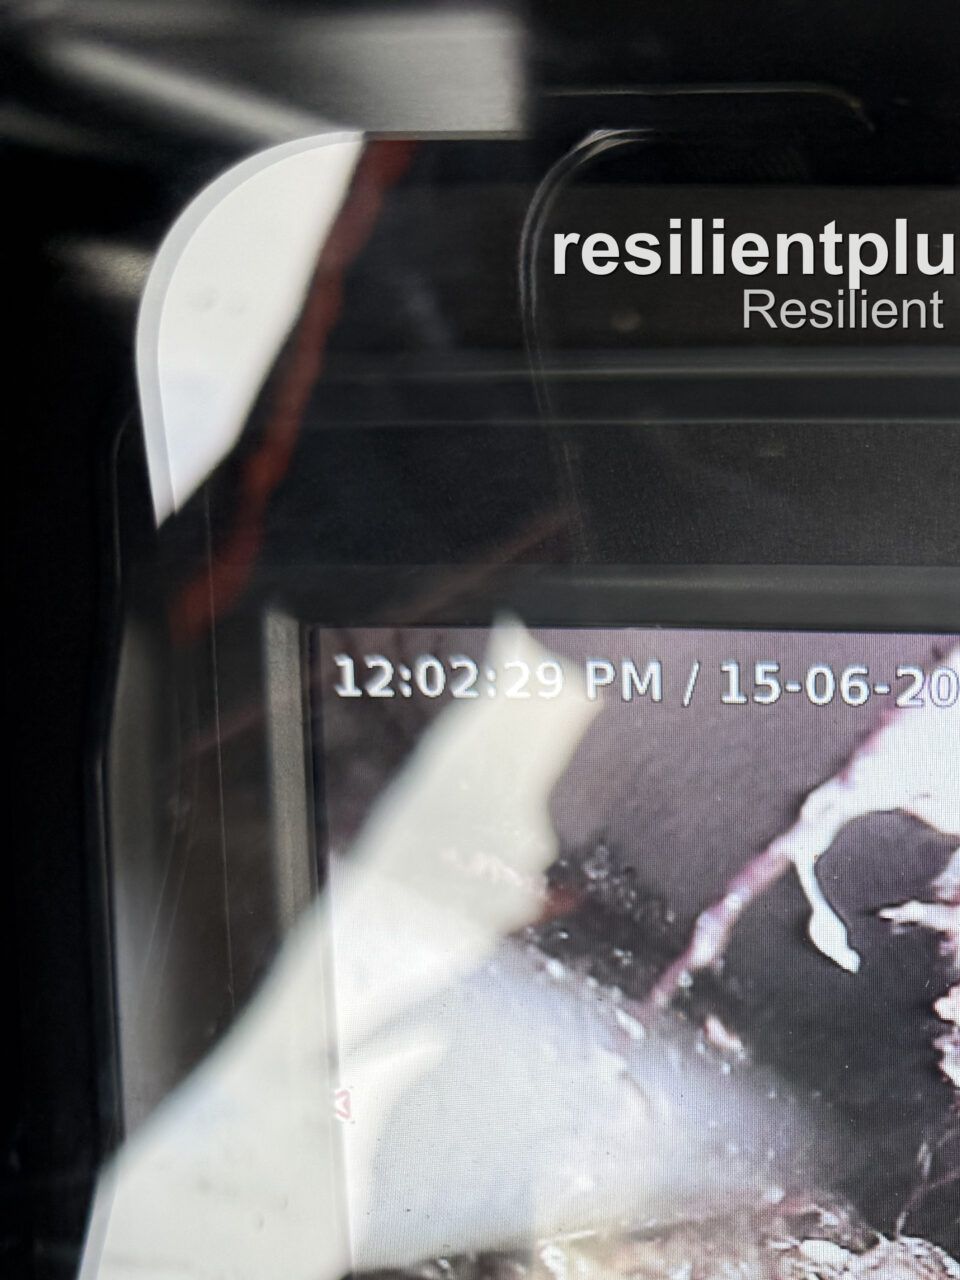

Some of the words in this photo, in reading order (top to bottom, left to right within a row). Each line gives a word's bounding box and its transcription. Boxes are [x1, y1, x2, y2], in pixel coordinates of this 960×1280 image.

[332, 655, 564, 699] 12:02:29
[585, 659, 663, 702] PM
[681, 660, 700, 706] /
